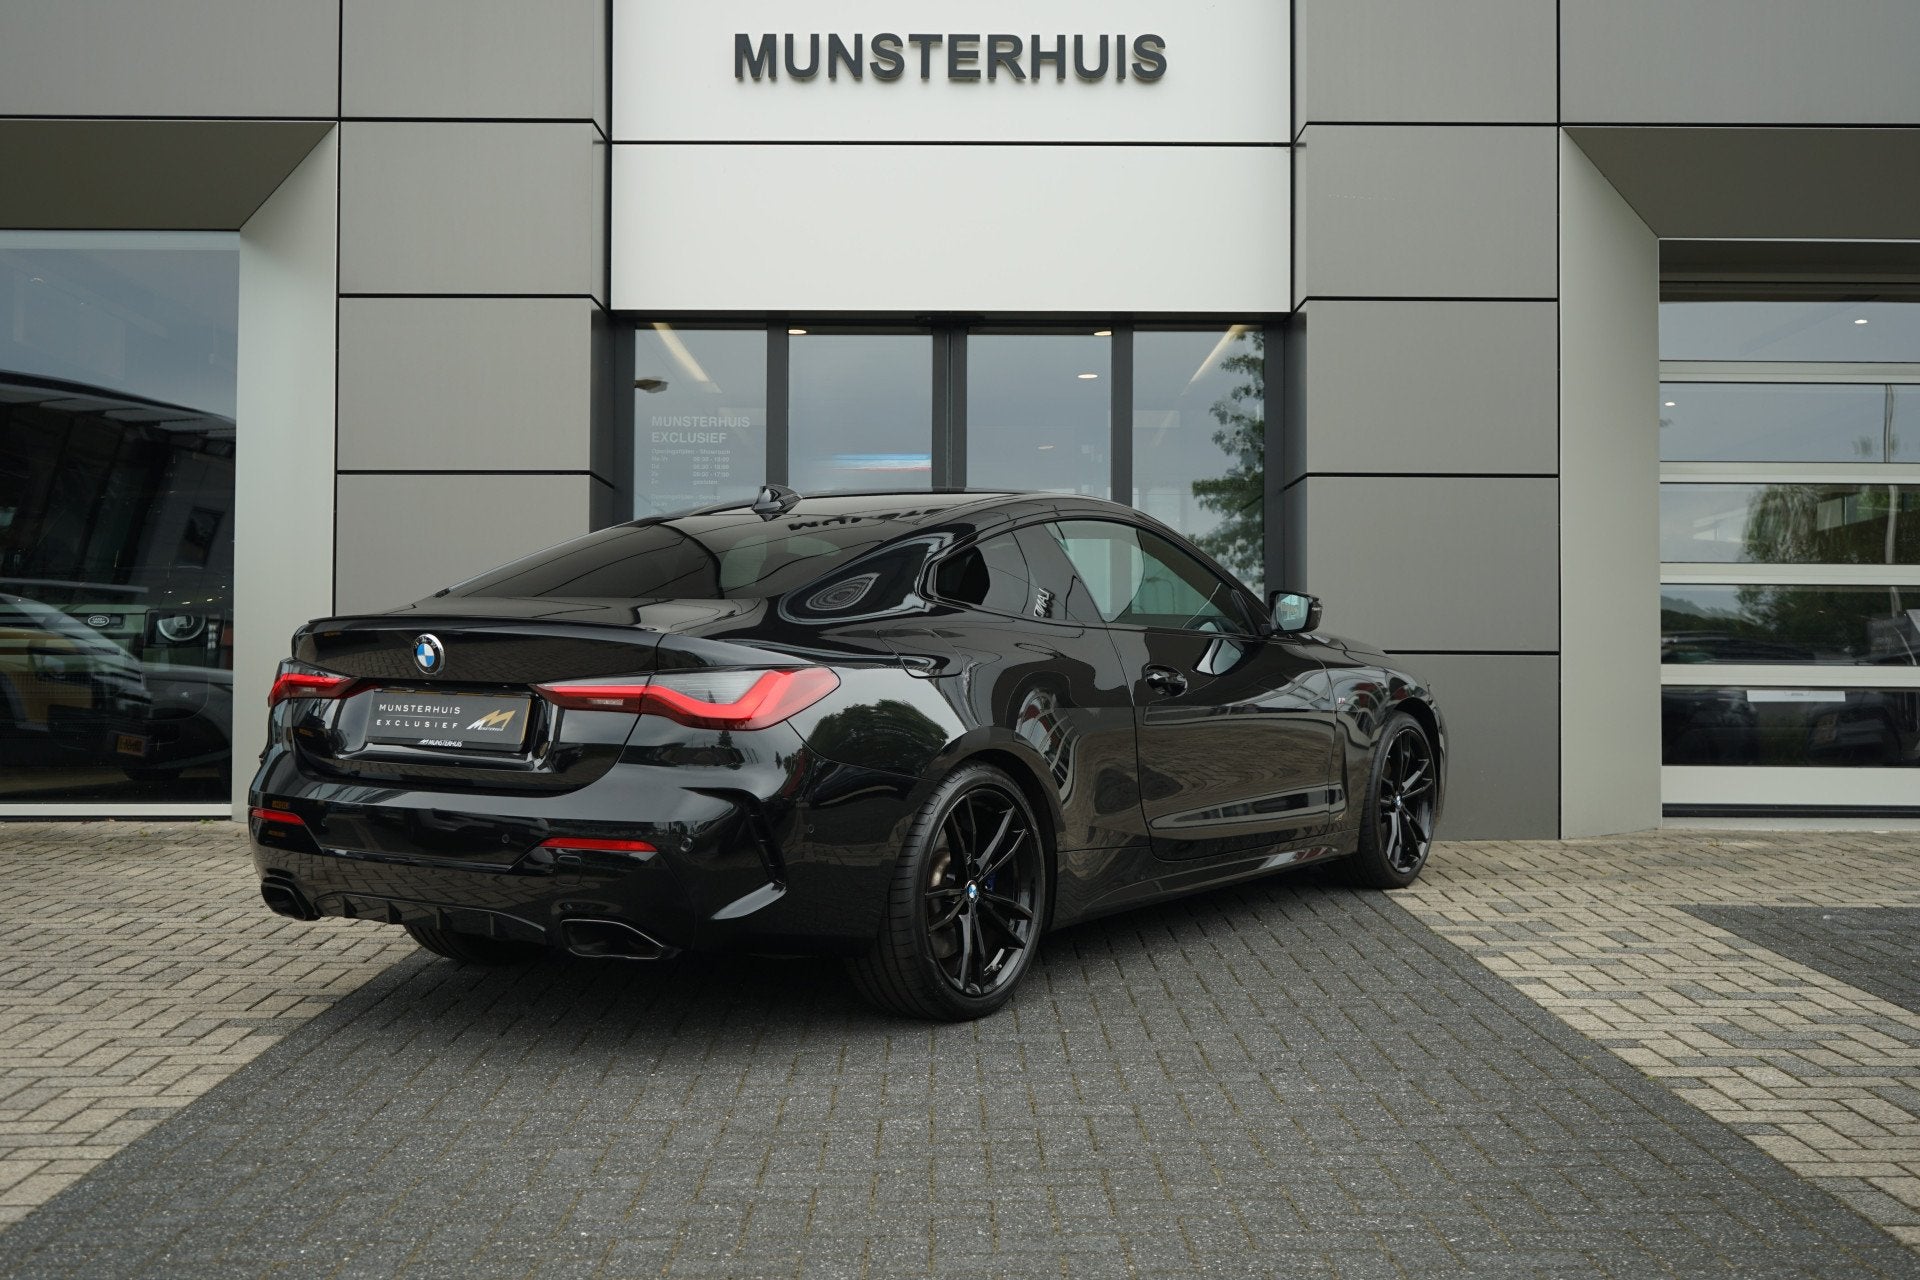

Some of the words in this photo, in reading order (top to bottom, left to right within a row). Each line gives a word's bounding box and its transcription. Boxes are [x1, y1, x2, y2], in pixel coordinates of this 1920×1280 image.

[734, 33, 1167, 81] MUNSTERHUIS
[651, 415, 751, 428] MUNSTERHUIS
[651, 431, 727, 444] EXCLUSIEF
[379, 704, 461, 715] MUNSTERHUIS
[376, 719, 459, 729] EXCLUSIEF
